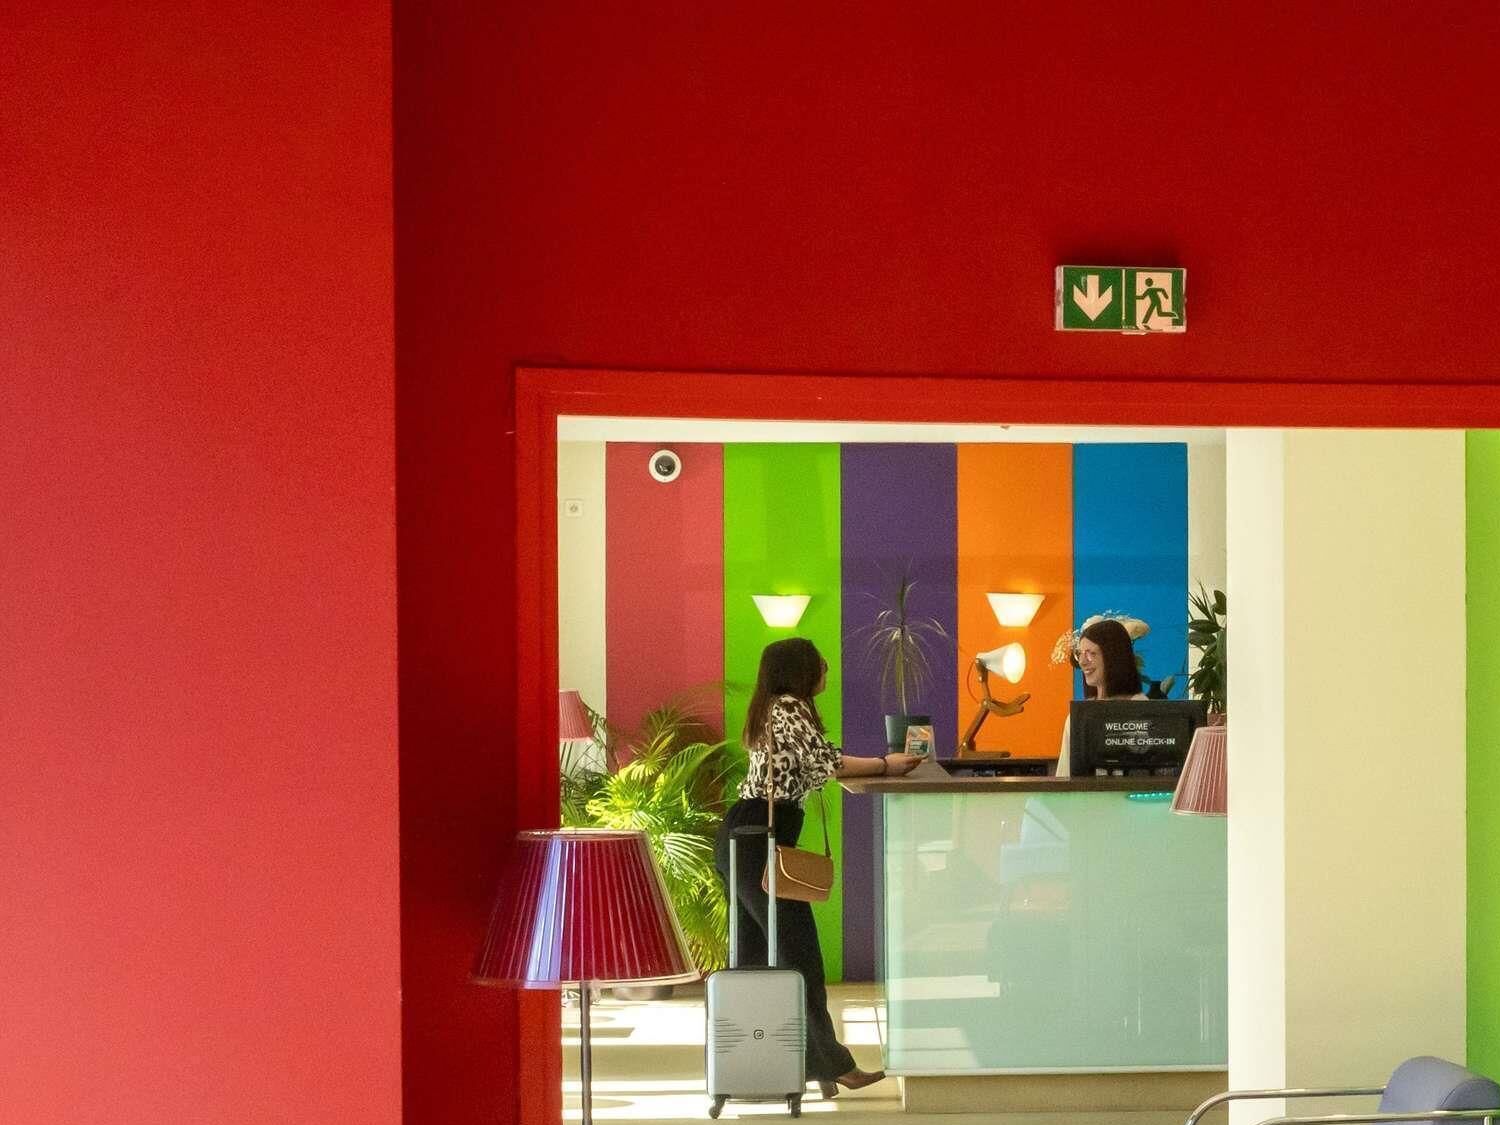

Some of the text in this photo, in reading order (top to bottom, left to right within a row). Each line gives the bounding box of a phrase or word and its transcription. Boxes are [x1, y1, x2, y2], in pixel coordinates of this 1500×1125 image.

[1105, 722, 1149, 731] WELCOME
[1105, 737, 1176, 746] ONLINE CHECK-IN
